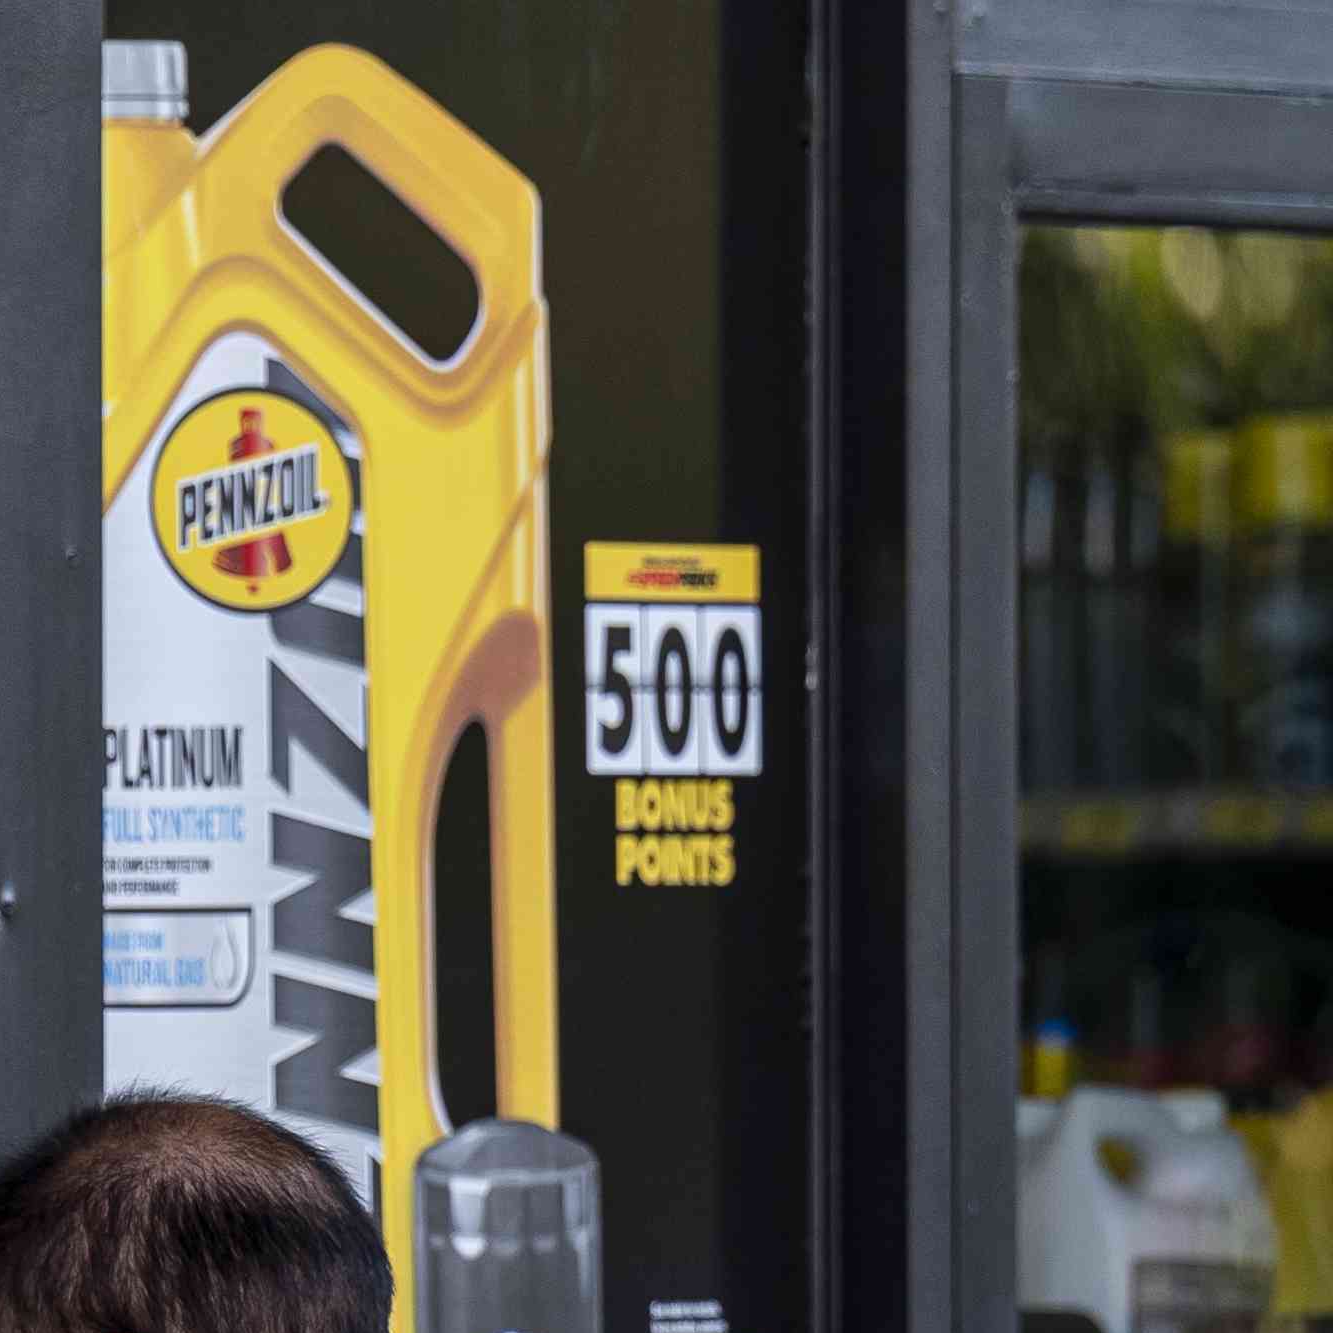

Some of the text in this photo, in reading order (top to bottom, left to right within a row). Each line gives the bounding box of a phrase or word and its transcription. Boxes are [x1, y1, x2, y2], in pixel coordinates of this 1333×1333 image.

[179, 450, 321, 549] PENNZOIL
[597, 626, 749, 756] 500
[103, 726, 243, 790] PLATINUM
[148, 805, 246, 843] SYNTHETIC
[615, 779, 734, 831] BONUS
[615, 833, 735, 886] POINTS
